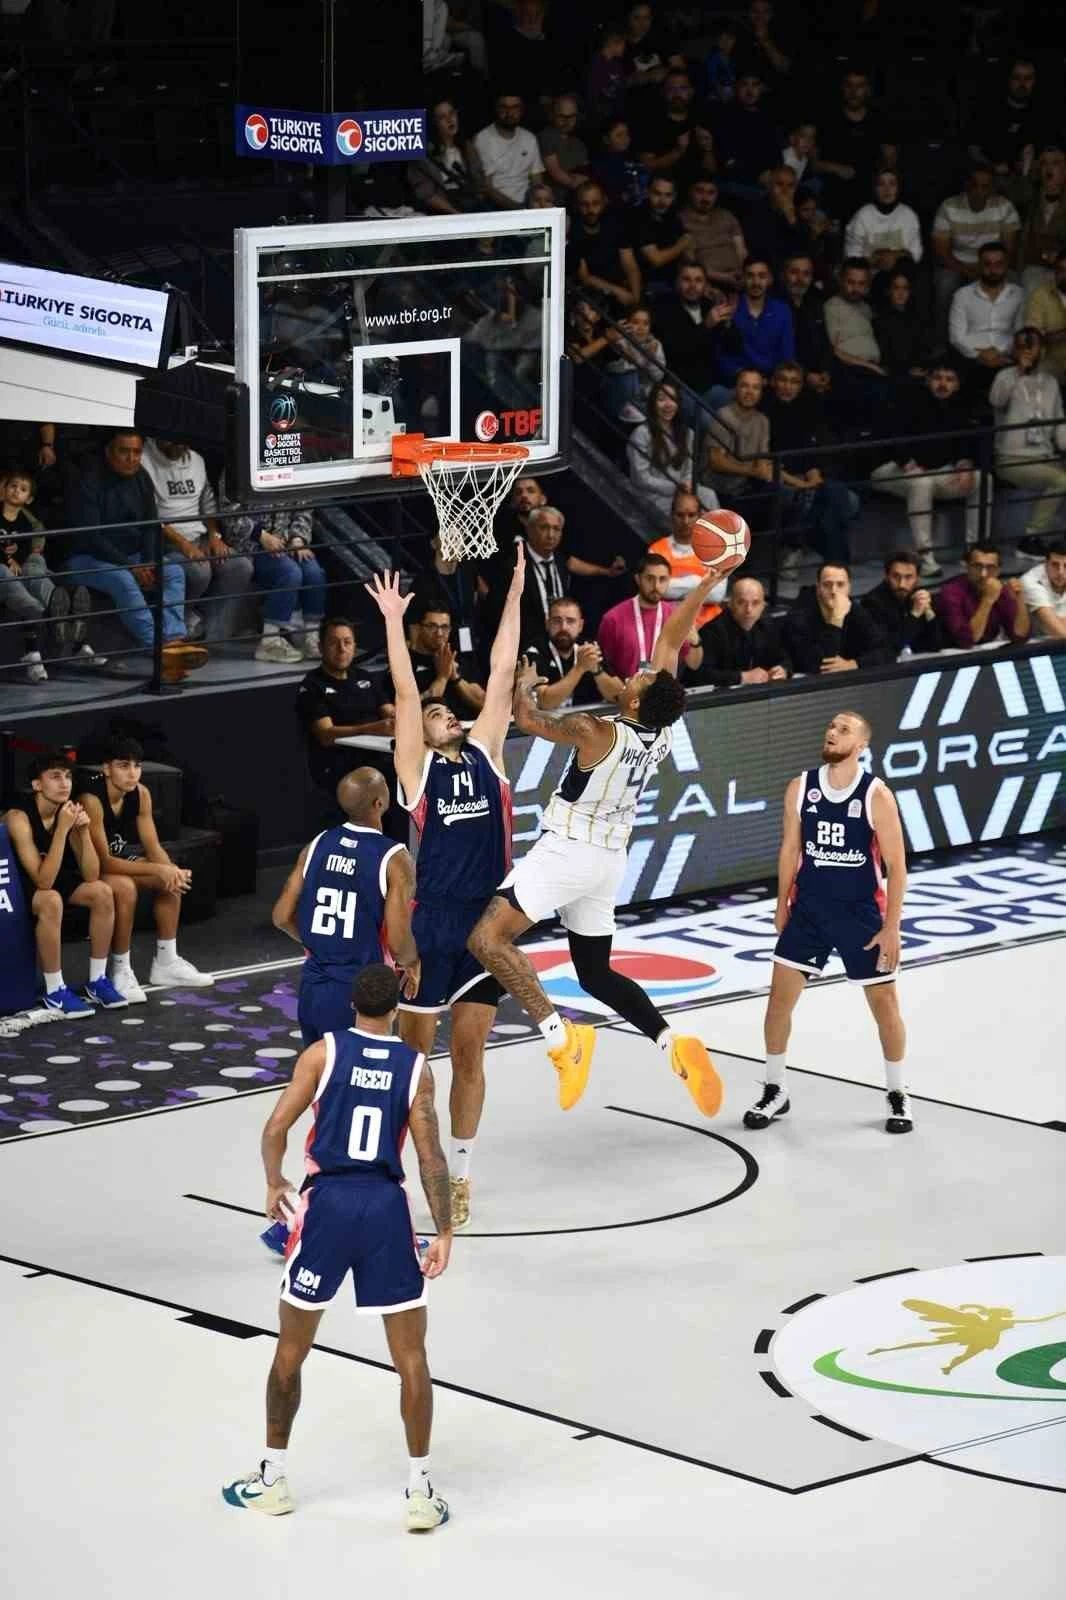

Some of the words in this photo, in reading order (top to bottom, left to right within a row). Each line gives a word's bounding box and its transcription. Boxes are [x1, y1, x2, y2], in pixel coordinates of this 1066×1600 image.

[270, 118, 322, 137] TÜRKİYE
[364, 118, 422, 136] TÜRKİYE
[270, 135, 323, 154] SİGORTA
[364, 135, 423, 152] SİGORTA
[4, 290, 75, 316] TÜRKİYE
[80, 306, 152, 332] SİGORTA
[365, 307, 452, 327] www.tbf.org.tr
[501, 408, 542, 437] TBF
[452, 770, 474, 797] 14
[817, 820, 846, 847] 22
[310, 887, 357, 939] 24
[351, 1066, 393, 1090] REED
[348, 1105, 382, 1161] 0
[296, 1267, 322, 1290] HDI
